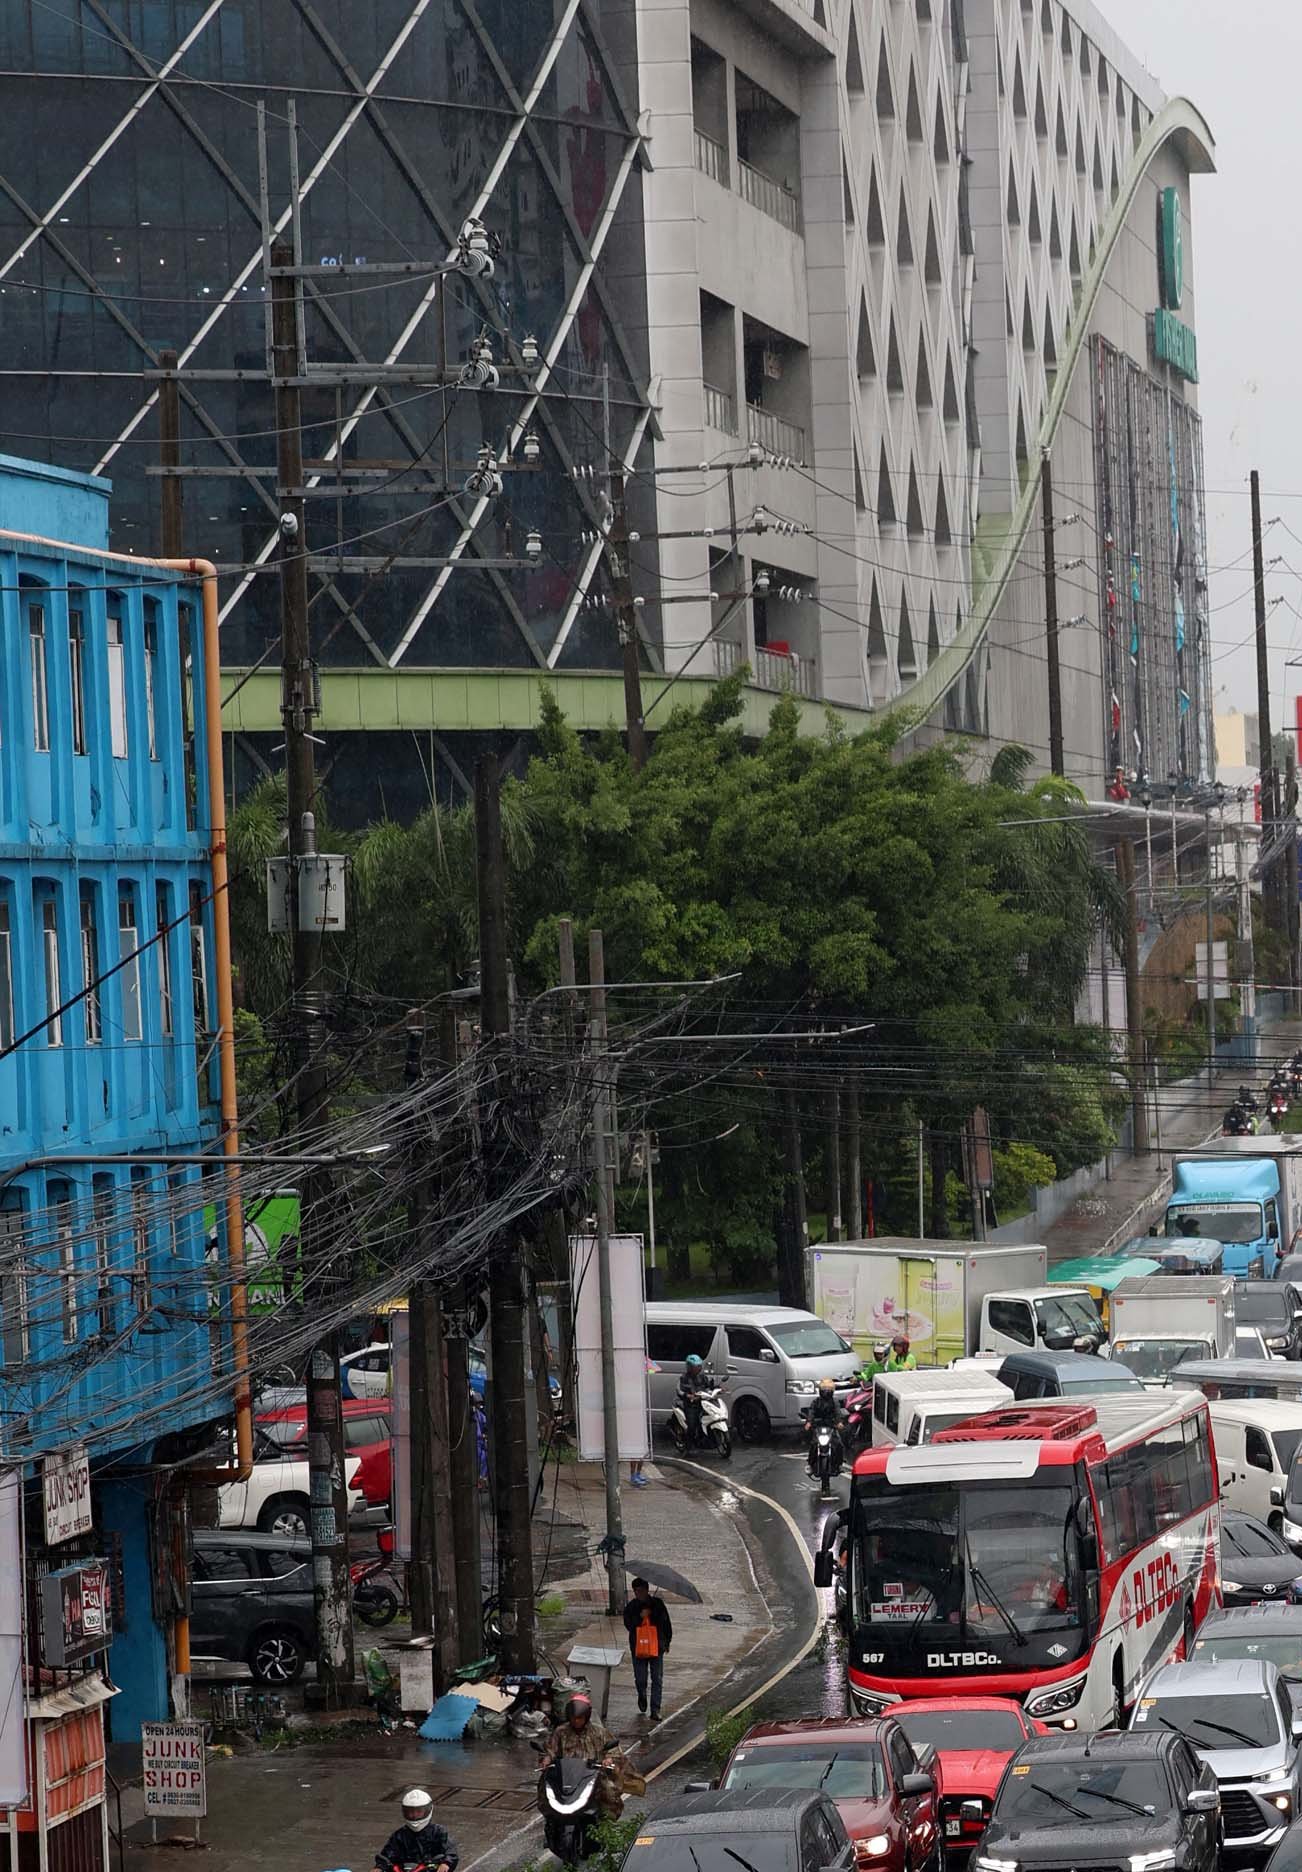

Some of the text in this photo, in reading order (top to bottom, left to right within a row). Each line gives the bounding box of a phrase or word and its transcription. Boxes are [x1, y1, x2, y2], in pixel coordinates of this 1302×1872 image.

[872, 1604, 929, 1613] LEMERY
[862, 1651, 1002, 1668] 567 DLTBCo.
[146, 1726, 199, 1737] OPEN 24 HOURS
[145, 1741, 201, 1759] JUNK
[145, 1771, 201, 1789] SHOP
